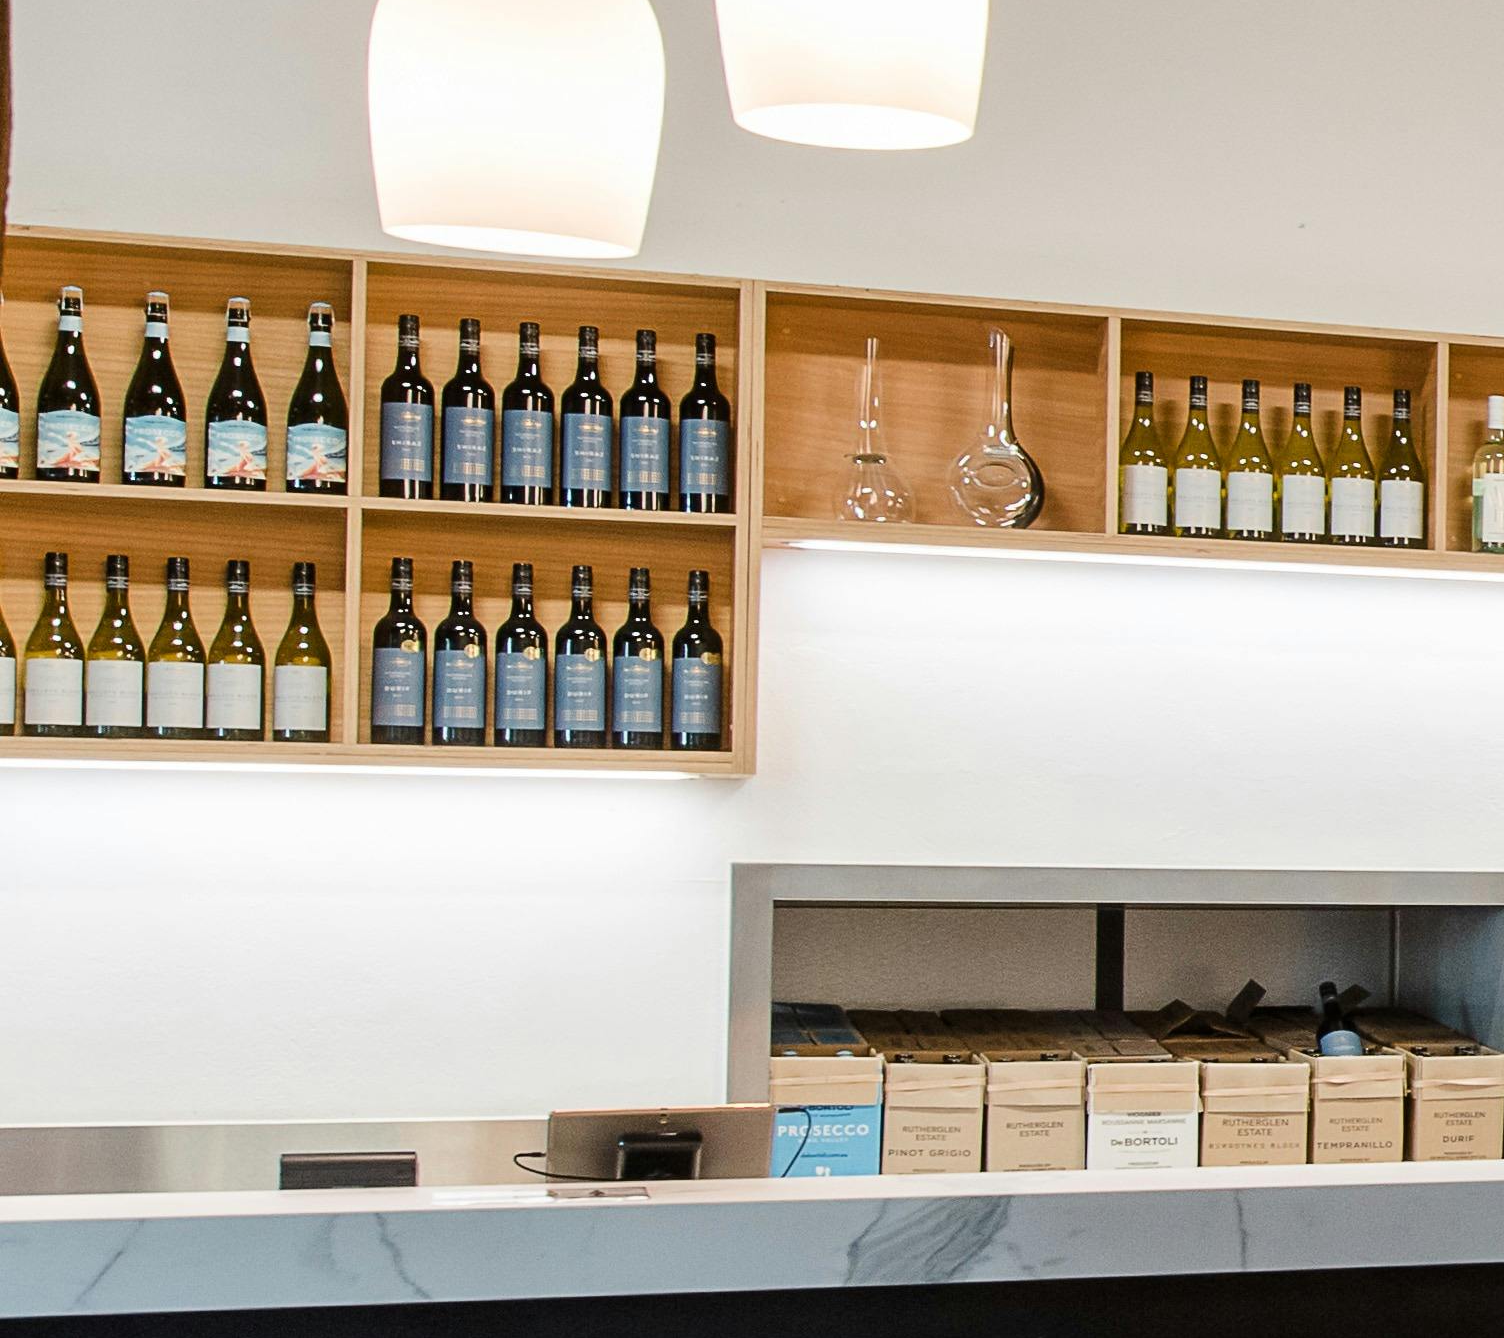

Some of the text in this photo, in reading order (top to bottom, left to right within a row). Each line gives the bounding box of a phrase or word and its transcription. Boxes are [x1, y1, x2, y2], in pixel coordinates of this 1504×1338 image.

[1222, 1118, 1289, 1127] RUTHERGLEN
[1329, 1117, 1383, 1125] RUTHERGLEN
[777, 1124, 870, 1137] PROSECCO
[902, 1125, 961, 1133] RUTHERGLEN
[1237, 1128, 1273, 1136] ESTATE
[1442, 1135, 1475, 1143] DURIF
[1316, 1141, 1393, 1150] TEMPRANILLO
[888, 1149, 971, 1157] PINOT GRIGIO
